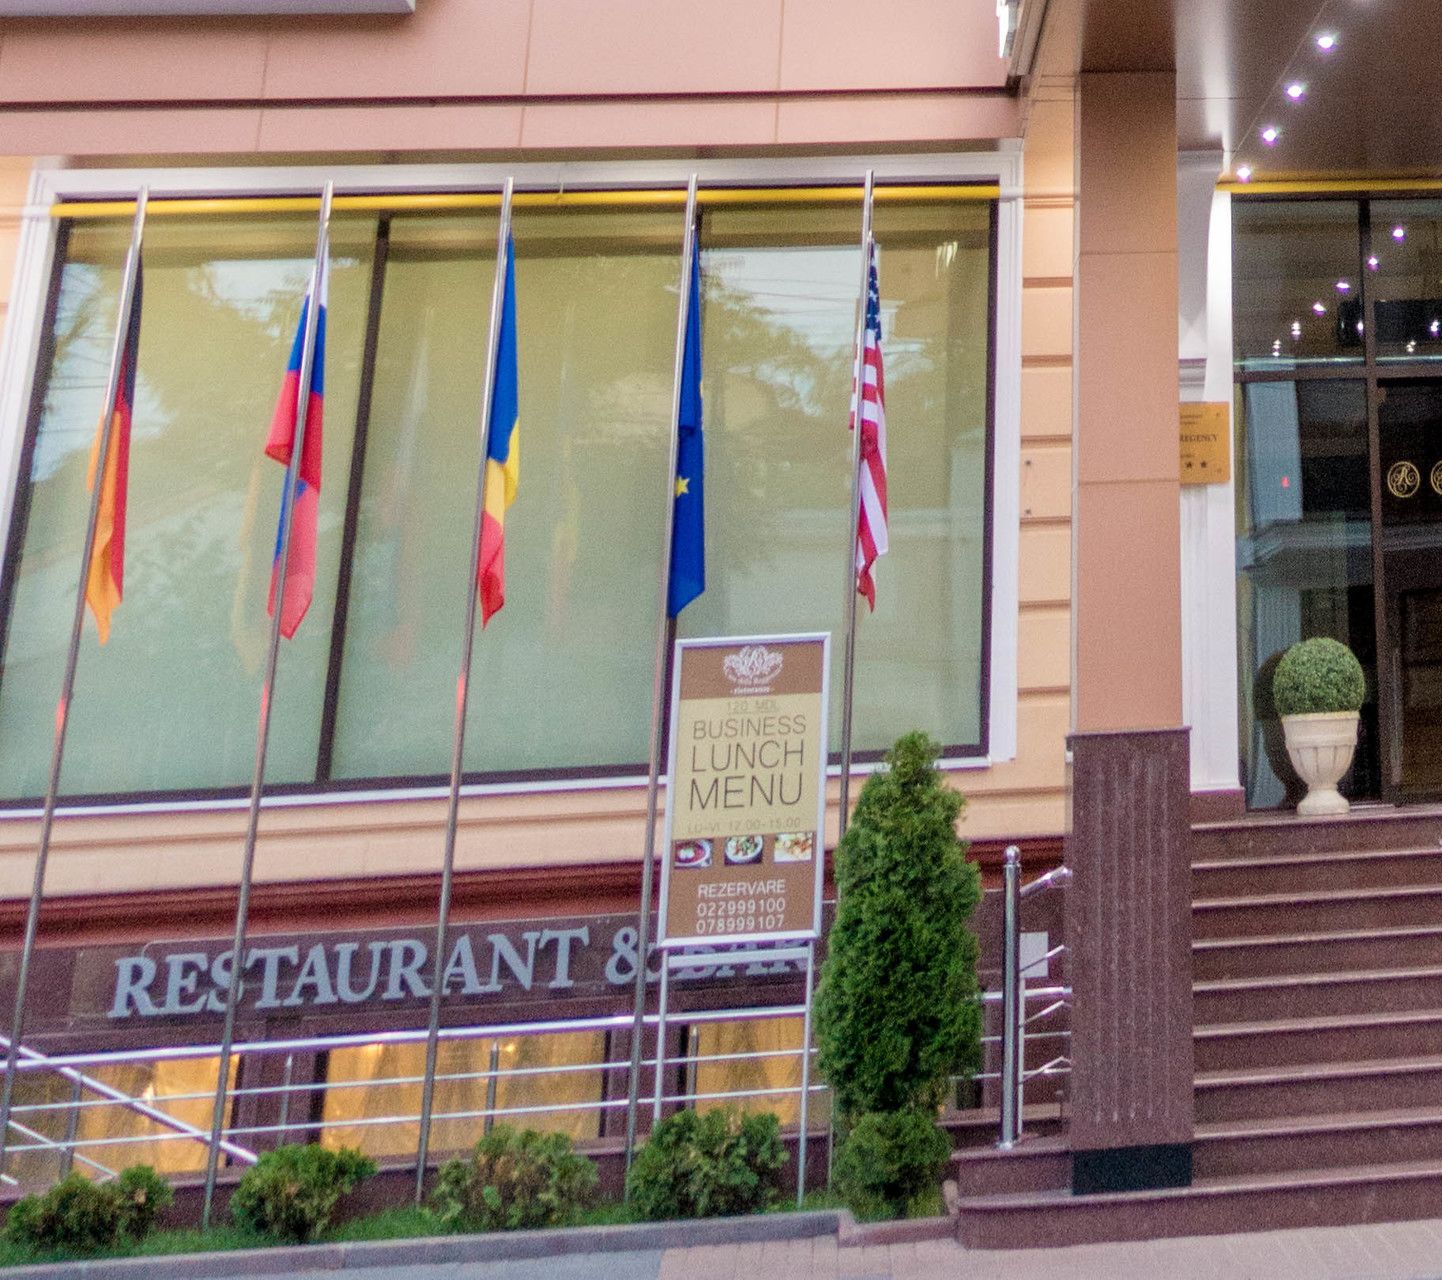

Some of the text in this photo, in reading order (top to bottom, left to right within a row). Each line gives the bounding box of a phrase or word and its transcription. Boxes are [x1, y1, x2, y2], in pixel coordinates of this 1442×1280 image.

[693, 714, 807, 740] BUSINESS
[692, 739, 804, 772] LUNCH
[690, 772, 803, 811] MENU
[698, 879, 786, 898] REZERVARE
[697, 897, 786, 917] 022999100
[695, 914, 785, 934] 078999107
[107, 925, 590, 1019] RESTAURANT
[604, 926, 668, 985] &
